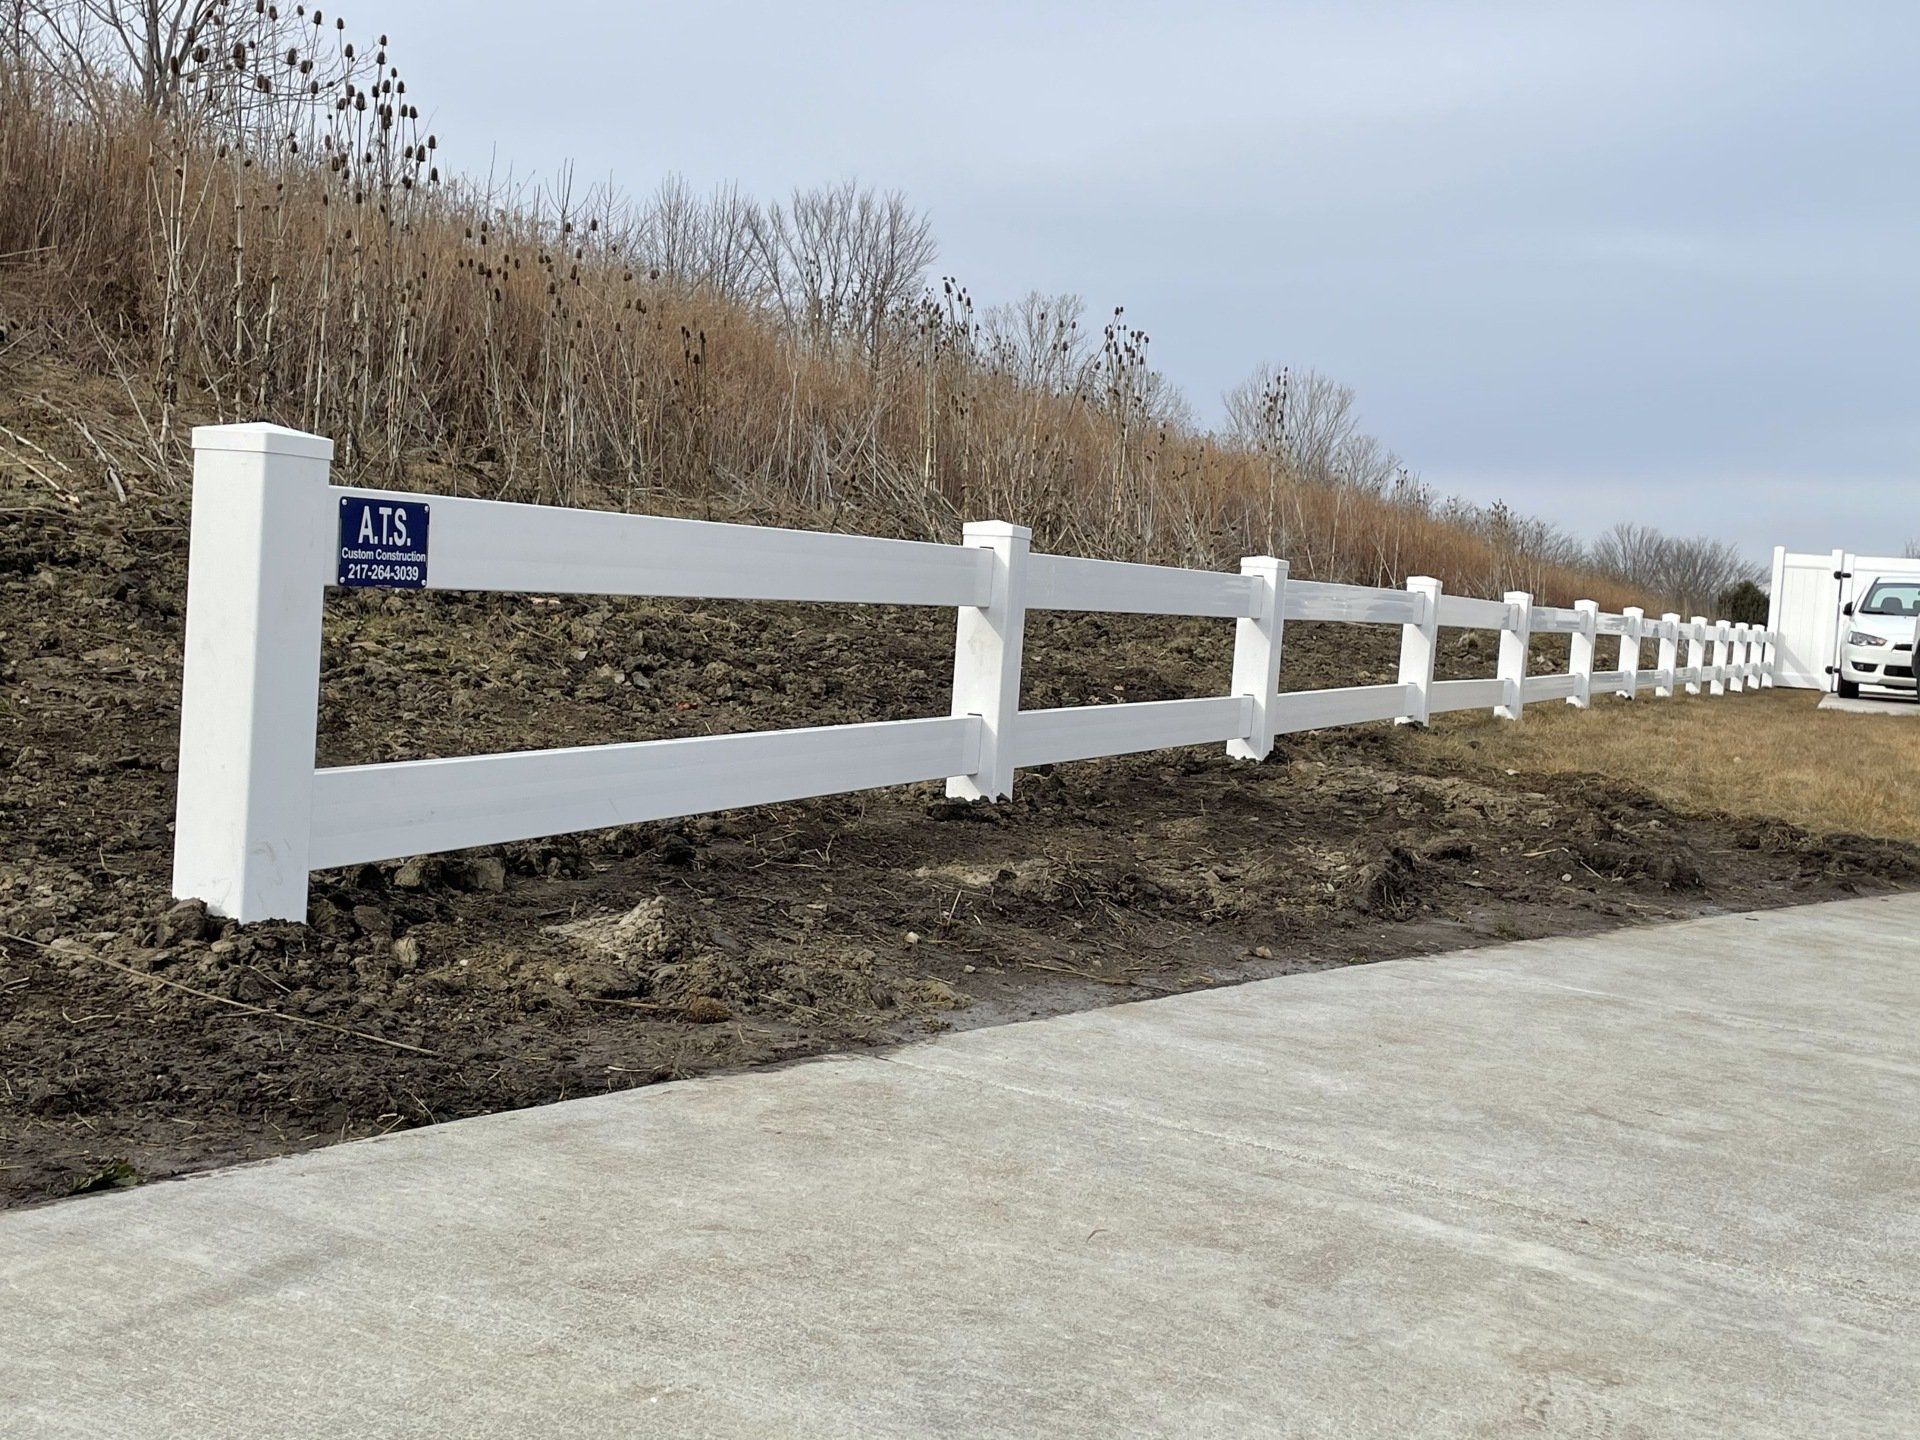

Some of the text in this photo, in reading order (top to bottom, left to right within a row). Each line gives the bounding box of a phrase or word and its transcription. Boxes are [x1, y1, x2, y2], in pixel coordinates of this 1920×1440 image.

[358, 505, 411, 546] A.T.S.
[342, 547, 426, 562] Custom Construction
[348, 564, 419, 580] 217-264-3039
